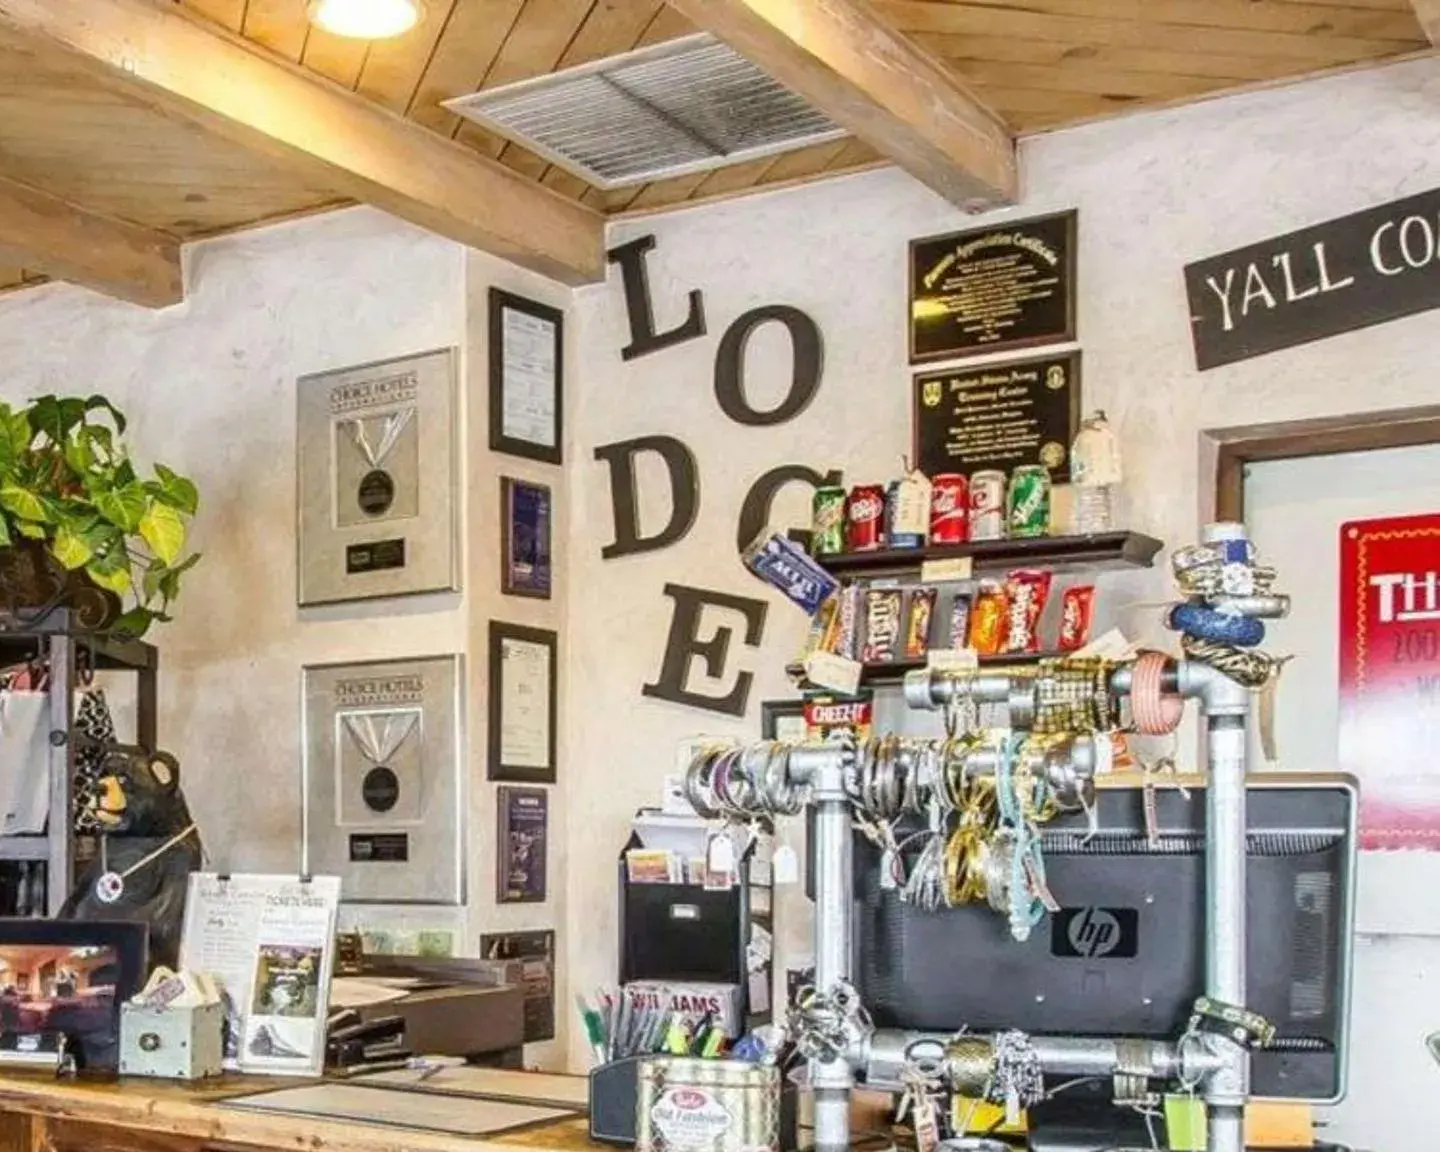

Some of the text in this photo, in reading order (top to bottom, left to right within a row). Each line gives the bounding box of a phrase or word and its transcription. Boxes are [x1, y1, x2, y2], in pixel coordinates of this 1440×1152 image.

[1205, 214, 1440, 332] YA'LL CO
[1368, 571, 1440, 623] TH
[1076, 906, 1115, 958] hp
[631, 991, 721, 1014] WILIAMS
